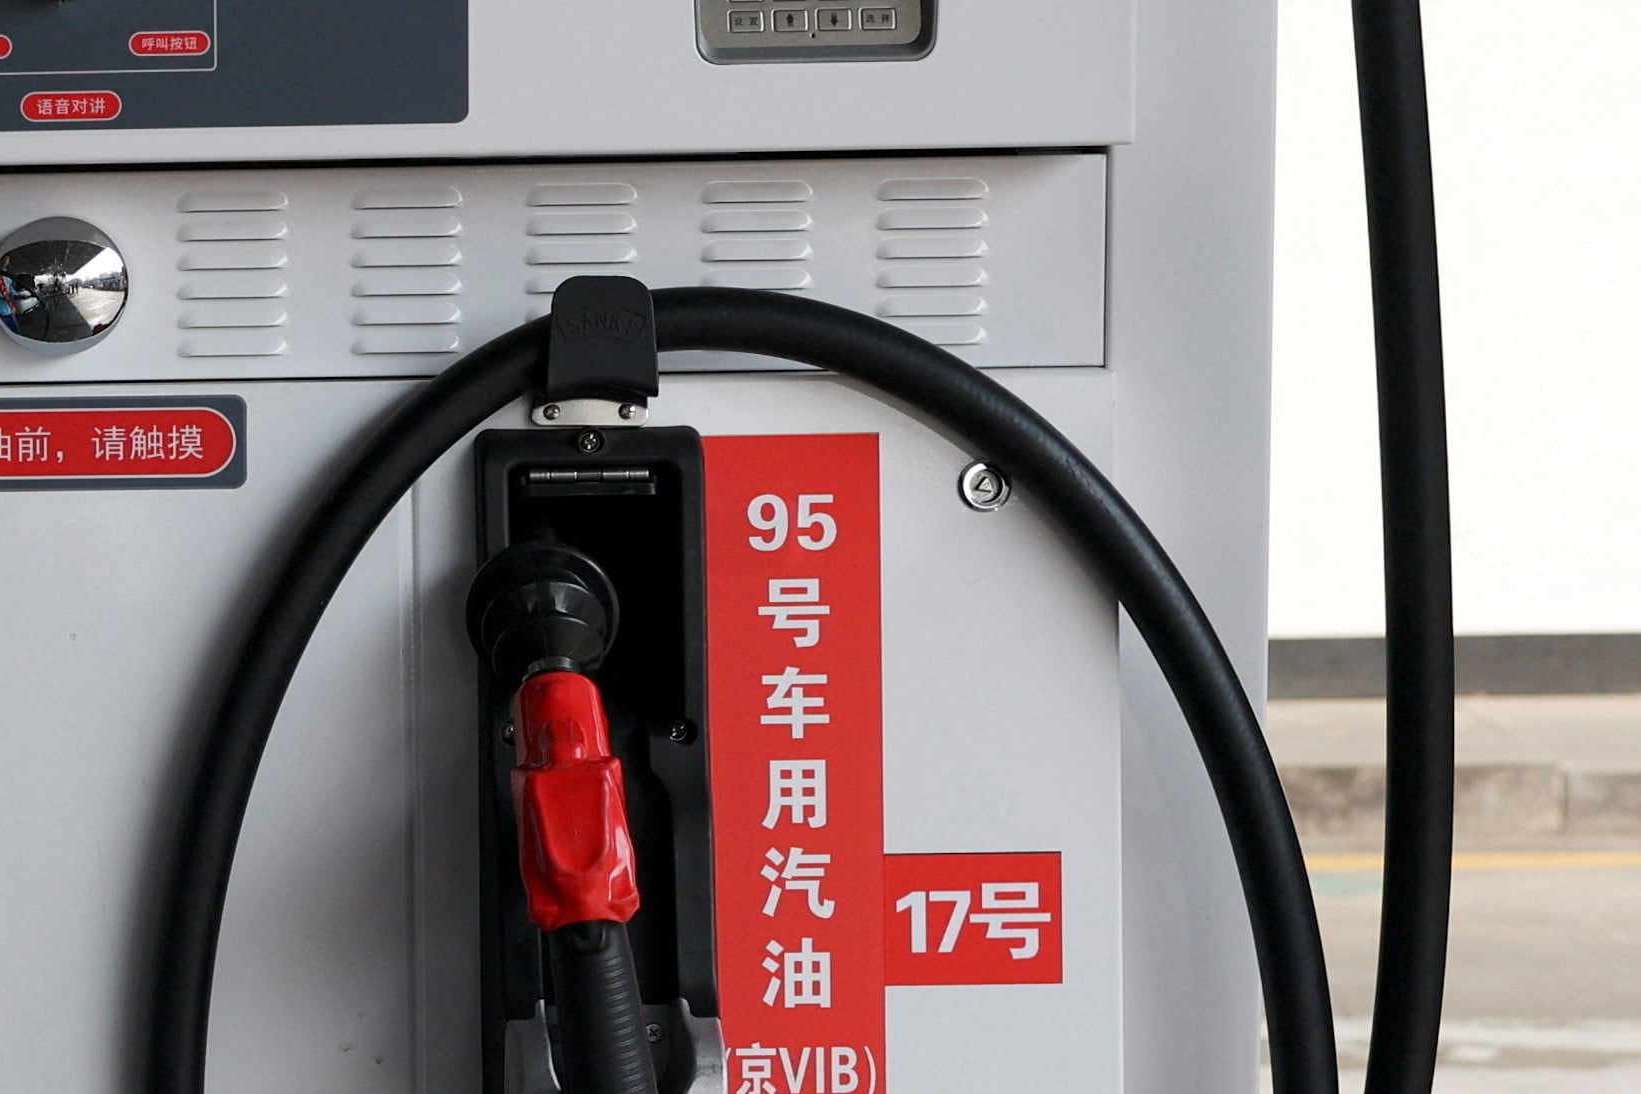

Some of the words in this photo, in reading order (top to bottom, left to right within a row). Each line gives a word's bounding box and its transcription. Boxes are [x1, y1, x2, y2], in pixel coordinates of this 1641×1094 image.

[865, 14, 891, 24] 选择
[141, 36, 197, 52] 呼叫按钮
[37, 97, 106, 116] 语音对讲
[747, 493, 838, 1009] 95号车用汽油
[895, 881, 1053, 961] 17号
